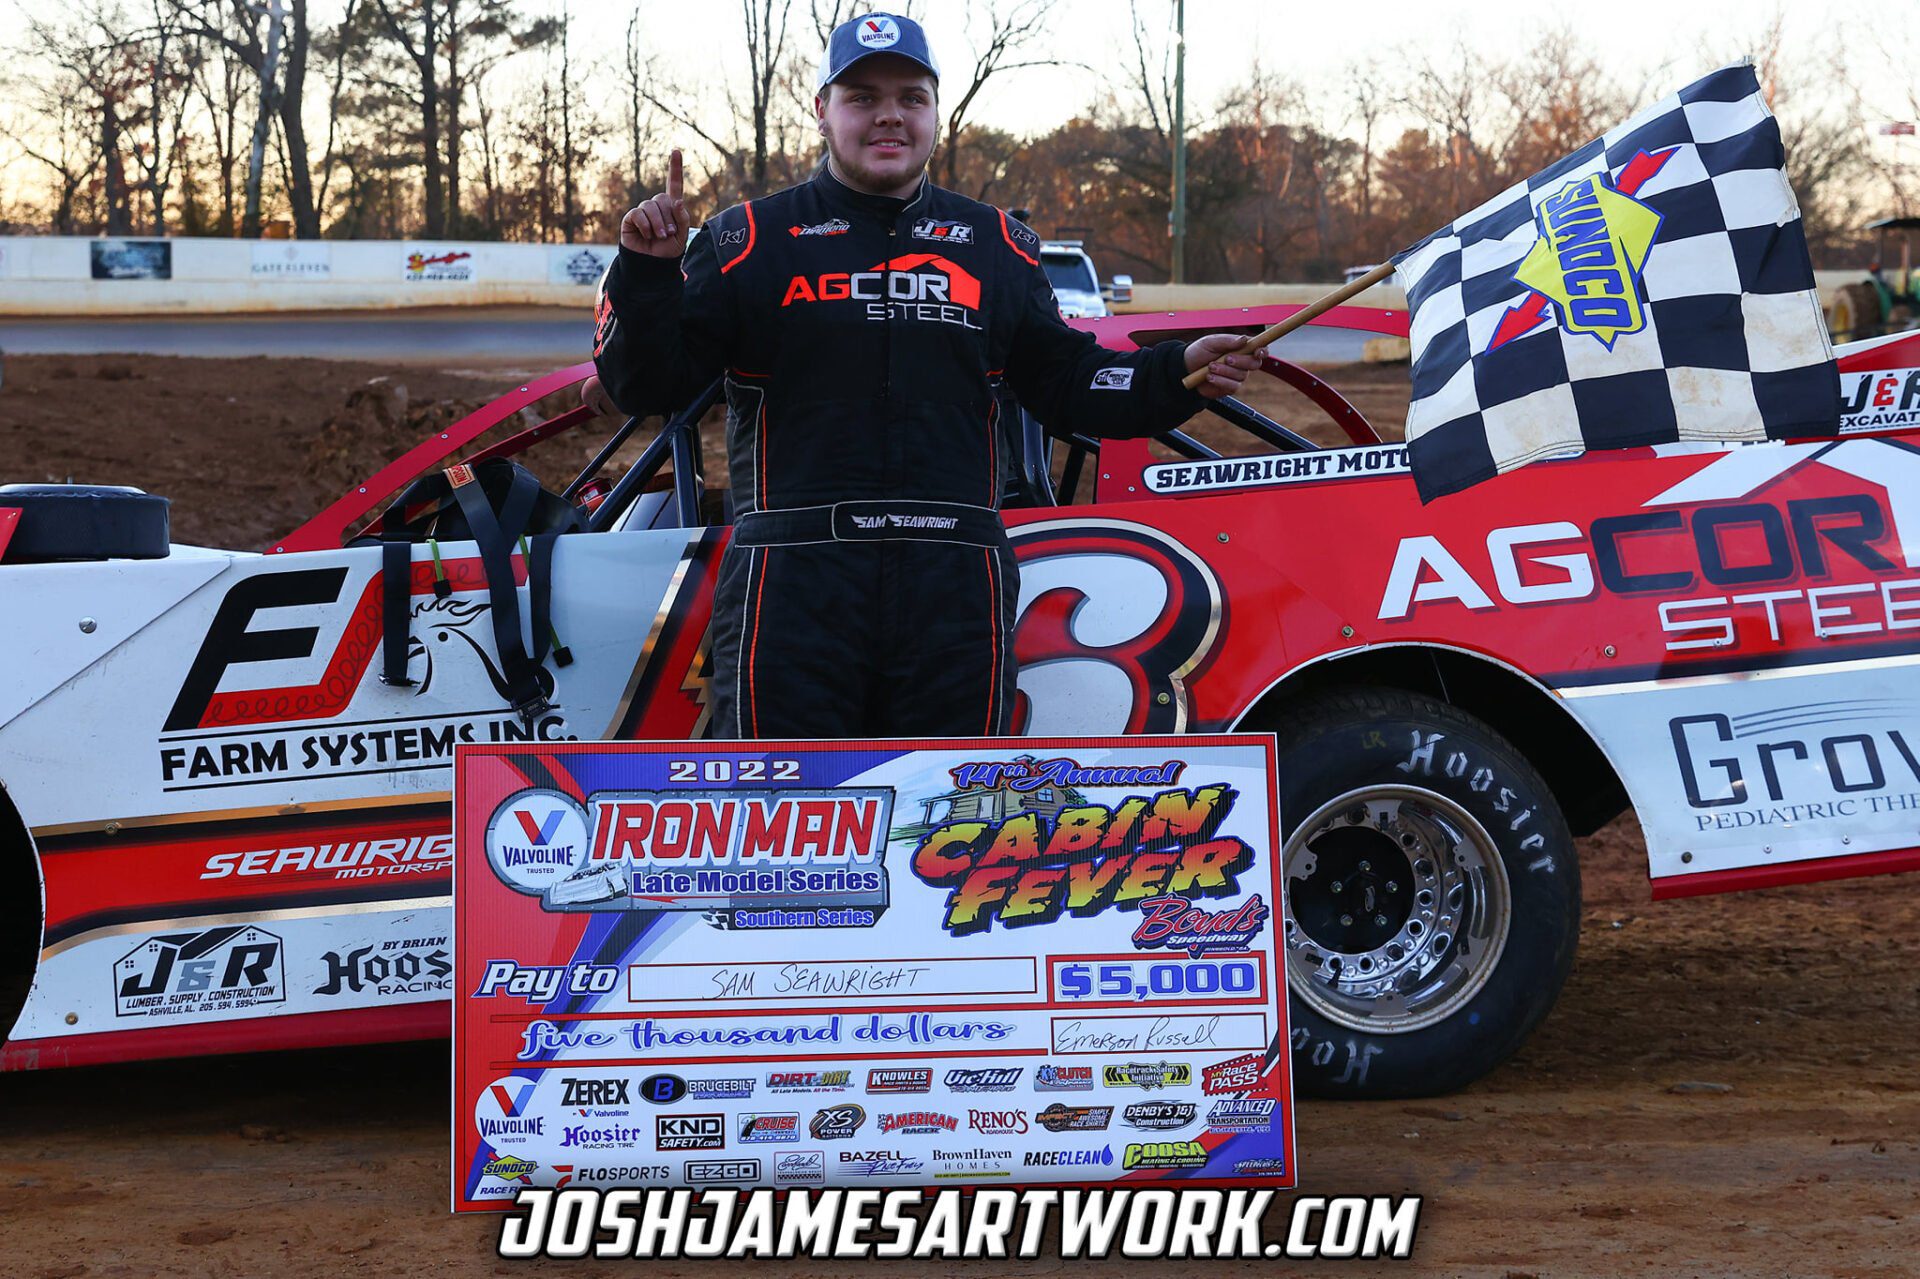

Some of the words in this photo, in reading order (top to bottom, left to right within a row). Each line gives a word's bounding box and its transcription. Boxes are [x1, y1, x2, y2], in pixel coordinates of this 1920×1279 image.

[862, 32, 894, 42] VALVOLINE
[1545, 179, 1632, 327] SUNOCO
[781, 271, 949, 307] AGCOR
[867, 301, 983, 330] STEEL
[1156, 456, 1332, 488] SEAWRIGHT
[851, 514, 887, 528] SAM
[887, 513, 959, 529] SEAWRIGHT
[1376, 494, 1899, 619] AGCOR
[160, 739, 288, 780] FARM
[669, 760, 800, 782] 2022
[1015, 761, 1184, 788] Annual
[1396, 729, 1556, 873] Hoosier
[1695, 799, 1855, 831] PEDIATRIC
[591, 800, 736, 860] IRON
[742, 800, 879, 858] MAN
[912, 785, 1233, 882] CABIN
[199, 834, 452, 880] SEAWRIG
[502, 845, 574, 867] VALVOLINE
[334, 861, 452, 879] MOTORSP
[526, 867, 555, 875] TRUSTED
[632, 872, 694, 894] Late
[697, 870, 785, 892] Model
[789, 868, 880, 891] Series
[945, 838, 1249, 931] FEVER
[735, 910, 816, 928] Southern
[817, 909, 874, 926] Series
[1133, 894, 1266, 941] Boyd's
[381, 939, 401, 951] BY
[402, 936, 447, 949] BRIAN
[1167, 933, 1249, 944] Speedway
[119, 942, 279, 998] J&R
[478, 960, 563, 1003] Pay
[568, 961, 619, 995] to
[702, 969, 756, 1000] SAM
[774, 963, 931, 994] SEAWRIGHT
[1060, 963, 1255, 999] $5,000
[209, 985, 275, 1001] CONSTRUCTION
[519, 1020, 615, 1059] five
[623, 1017, 840, 1049] thousand
[855, 1015, 1016, 1042] dollars
[1143, 1015, 1220, 1051] Russell
[689, 1080, 755, 1091] BRUCEBILT
[769, 1072, 817, 1085] DIRT
[822, 1070, 851, 1085] DIRT
[872, 1071, 927, 1085] KNOWLES
[1210, 1071, 1258, 1091] PASS
[561, 1078, 630, 1107] ZEREX
[594, 1109, 629, 1117] Valvoline
[1126, 1105, 1173, 1116] DENBY'S
[1207, 1099, 1276, 1117] ADVANCED
[480, 1116, 544, 1137] VALVOLINE
[660, 1119, 720, 1135] KND
[755, 1116, 797, 1130] CRUISE
[817, 1110, 853, 1129] XS
[882, 1111, 960, 1134] AMERICAN
[968, 1109, 1028, 1134] RENO'S
[1136, 1118, 1185, 1126] Construction
[1207, 1117, 1269, 1125] TRANSPORTATION
[559, 1123, 641, 1147] Hoosier
[582, 1142, 616, 1150] RACING
[840, 1151, 903, 1162] BAZELL
[932, 1149, 1012, 1160] BrownHaven
[1124, 1141, 1207, 1169] COOSA
[483, 1163, 536, 1174] SUNOCO
[944, 1162, 1000, 1170] HOMES
[1023, 1150, 1101, 1166] RACECLEAN
[578, 1166, 670, 1181] FLOSPORTS
[480, 1186, 508, 1195] RACE
